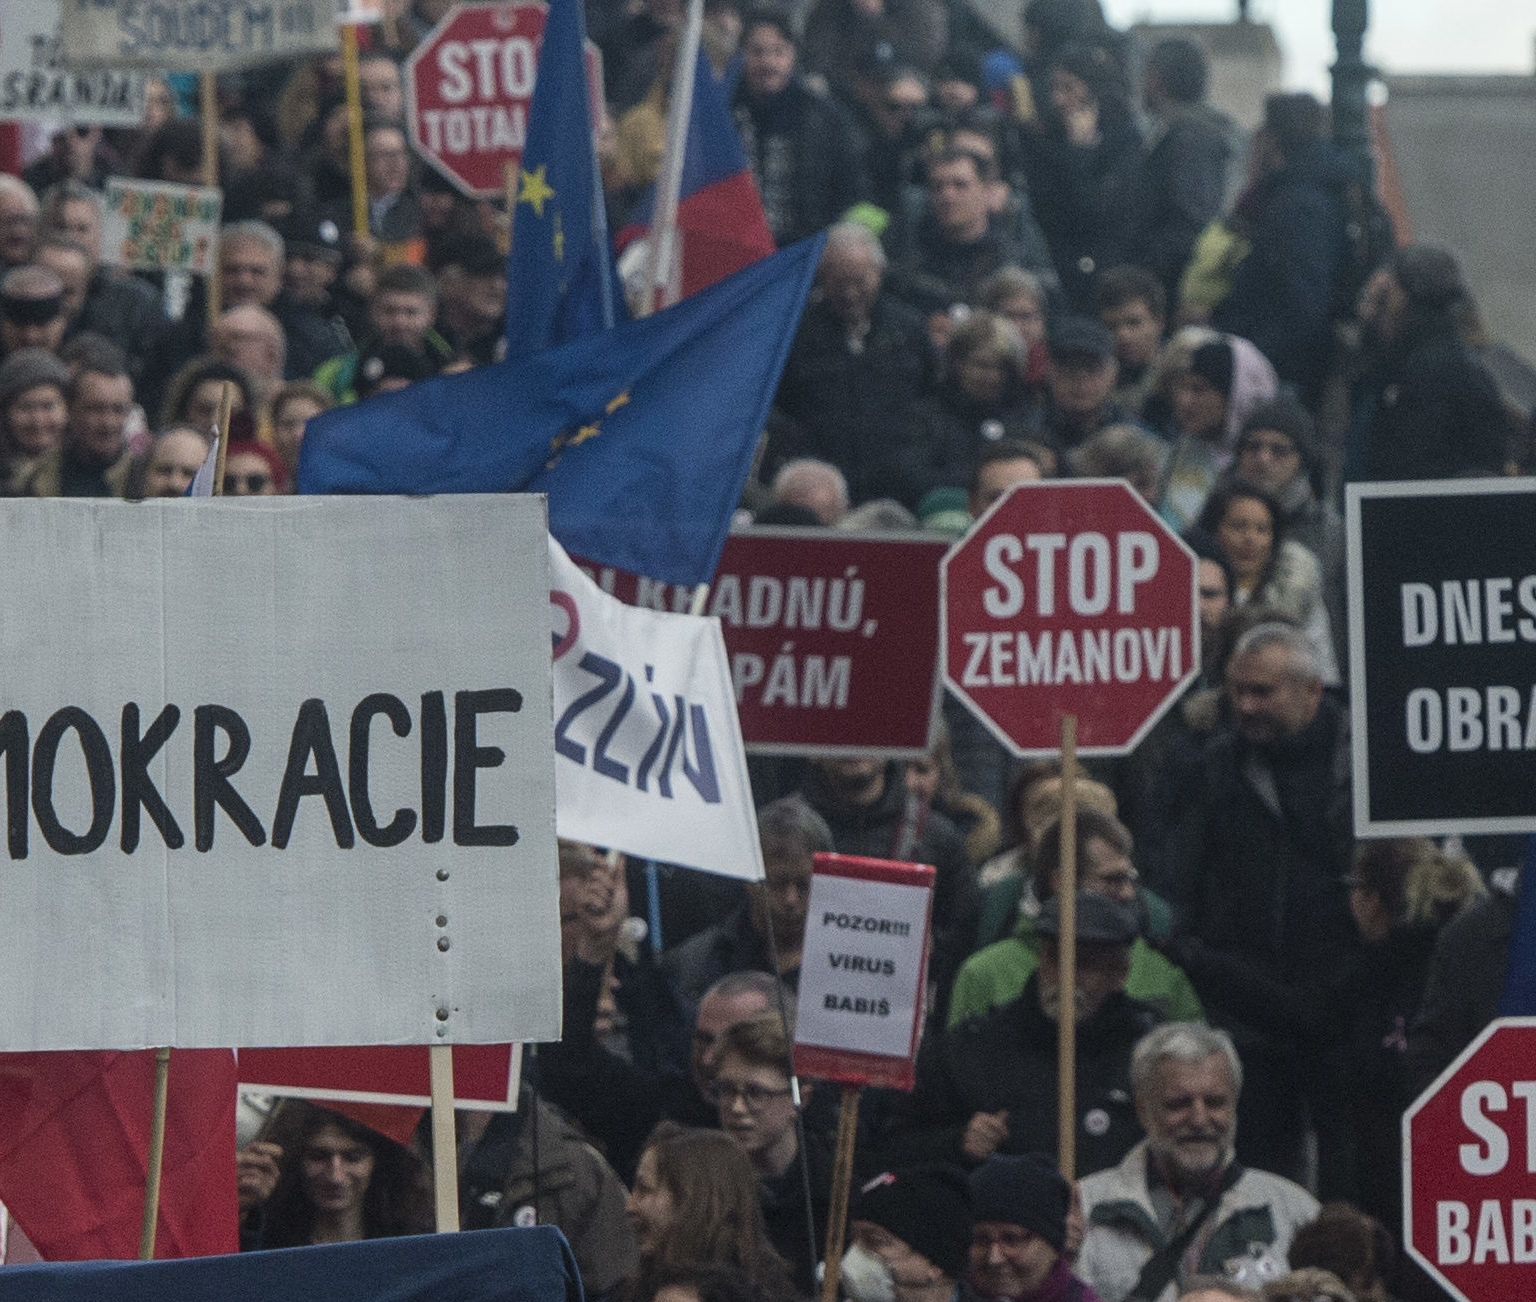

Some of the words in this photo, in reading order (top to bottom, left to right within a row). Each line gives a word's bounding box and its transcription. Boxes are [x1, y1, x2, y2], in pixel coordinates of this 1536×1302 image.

[438, 34, 541, 103] STO
[635, 565, 879, 639] KADNÚ,
[982, 530, 1161, 620] STOP
[962, 626, 1183, 688] ZEMANOVI
[822, 911, 911, 938] POZOR!!!
[828, 951, 896, 977] VIRUS
